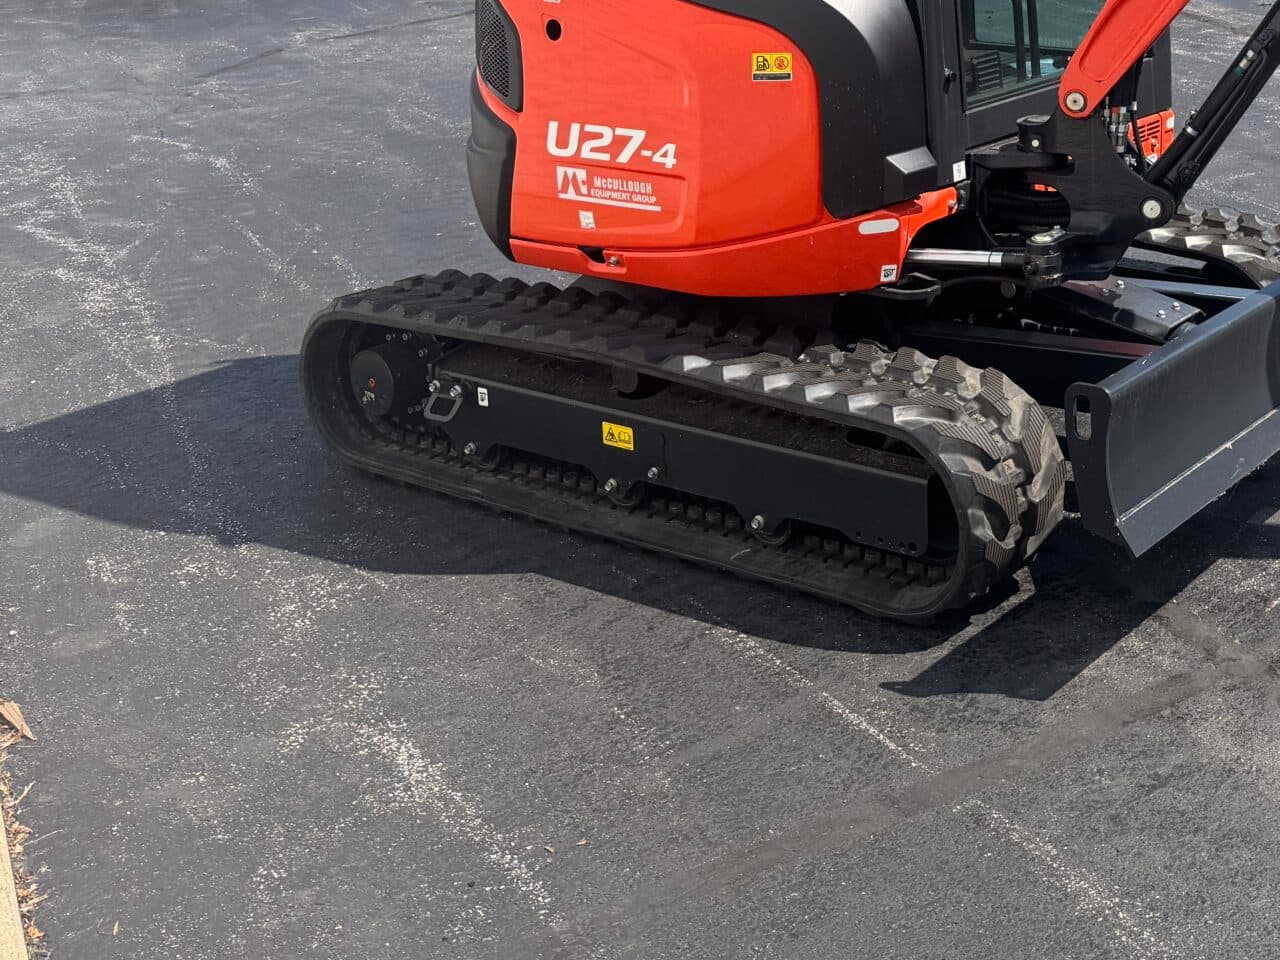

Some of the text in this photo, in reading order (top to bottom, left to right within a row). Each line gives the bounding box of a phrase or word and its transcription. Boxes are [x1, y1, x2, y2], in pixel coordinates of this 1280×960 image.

[547, 120, 677, 169] U27-4
[593, 176, 652, 194] McCULLOUGH
[591, 188, 657, 204] EQUIPMENT GROUP
